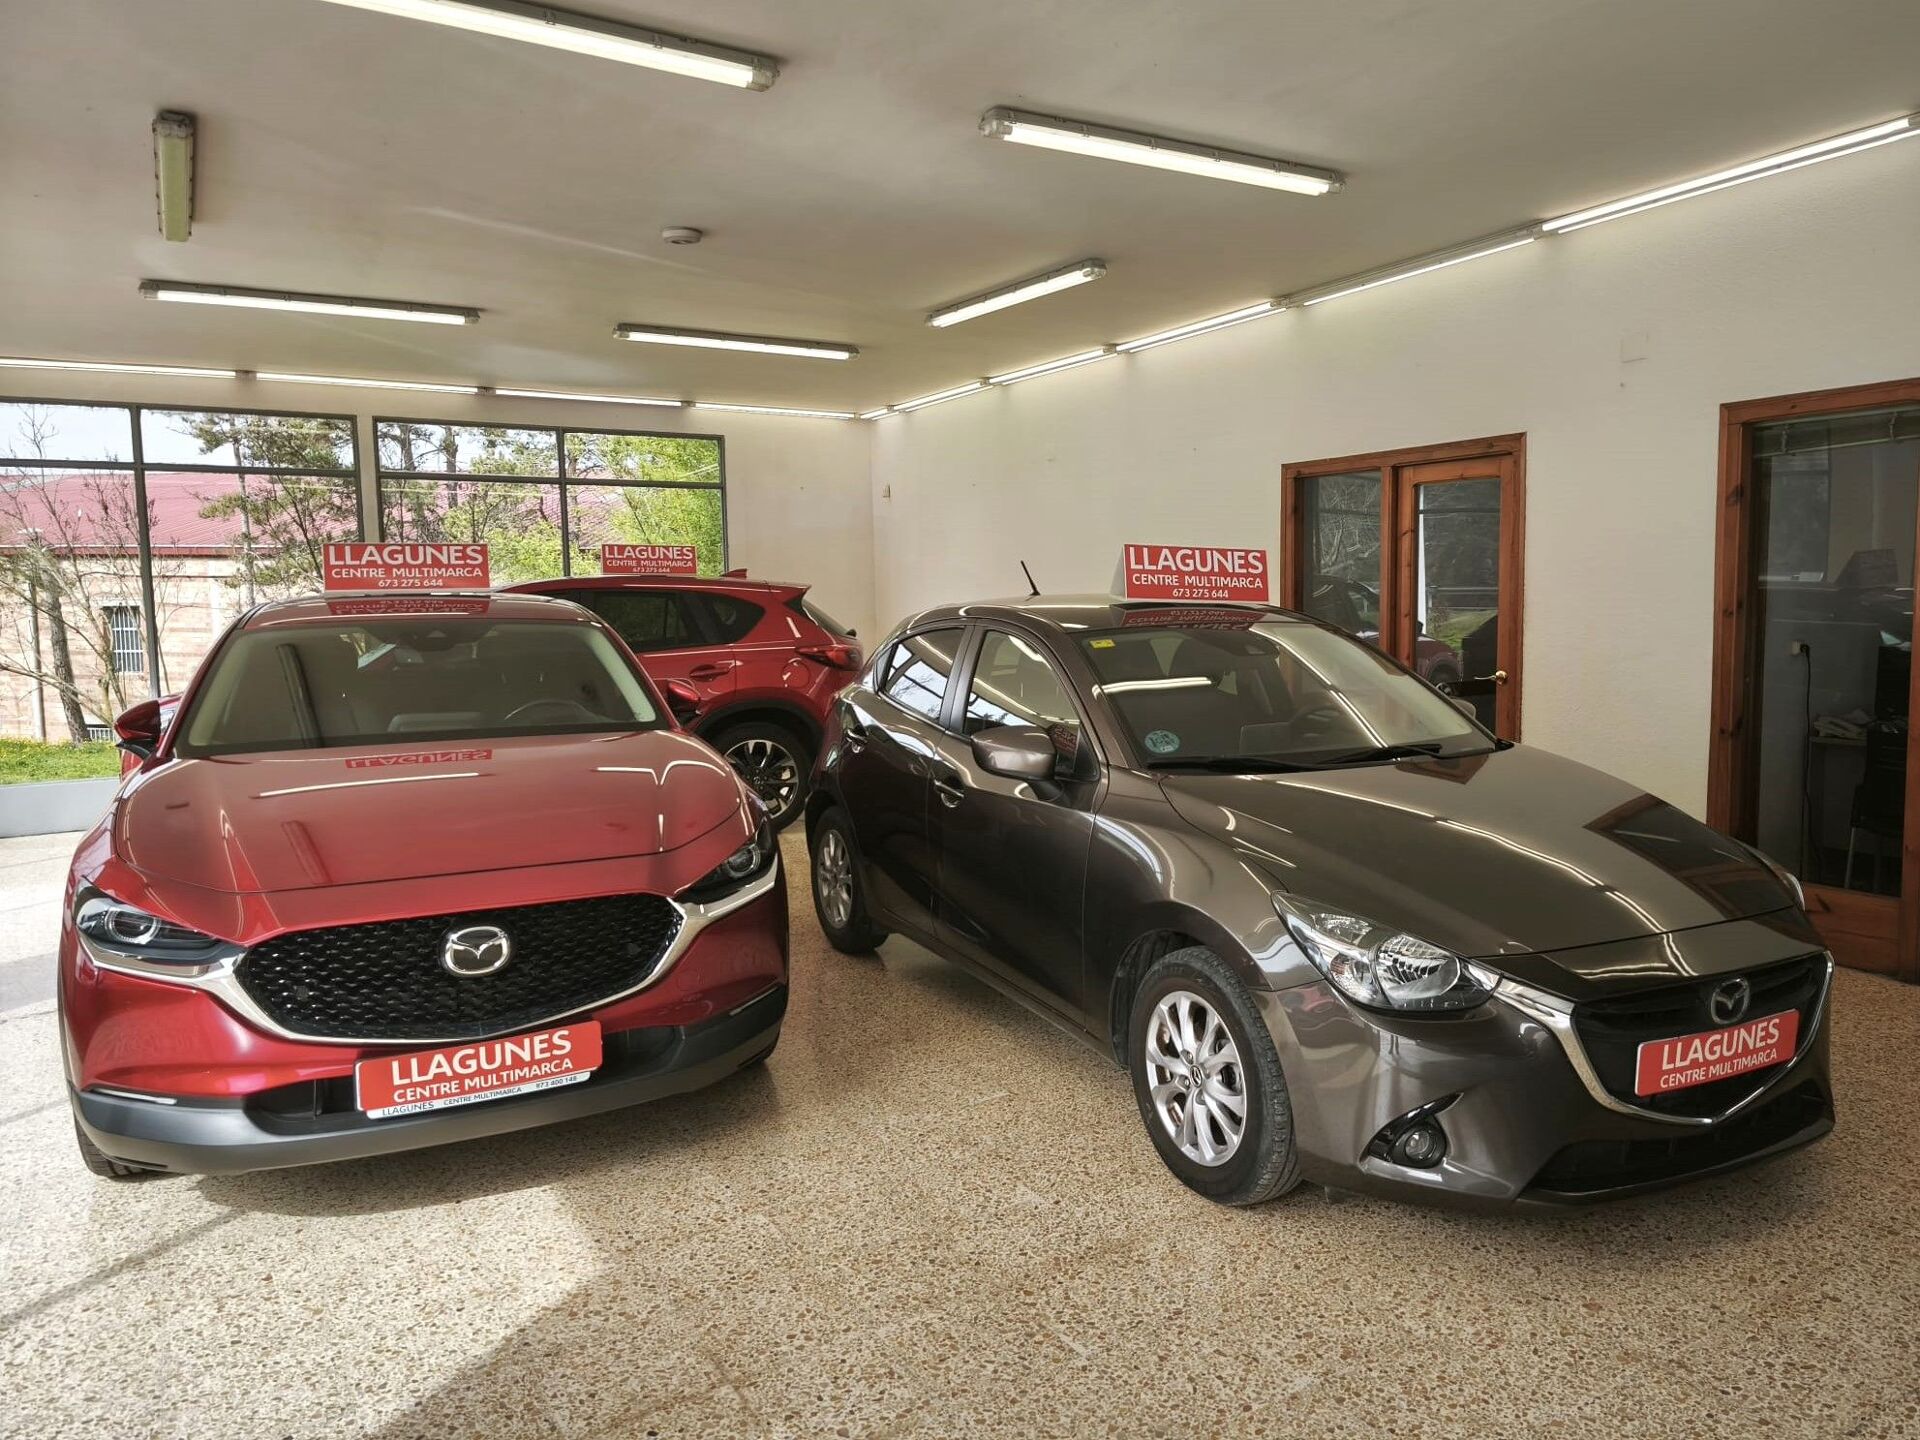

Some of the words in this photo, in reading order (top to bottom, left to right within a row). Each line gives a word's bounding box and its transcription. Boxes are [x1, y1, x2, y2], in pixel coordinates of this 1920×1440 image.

[329, 545, 483, 566] LLAGUNES
[605, 545, 693, 560] LLAGUNES
[1129, 546, 1264, 574] LLAGUNES
[332, 567, 386, 578] CENTRE
[393, 567, 483, 578] MULTIMARCA
[641, 560, 693, 568] MULTIMARCA
[378, 579, 398, 588] 673
[401, 579, 421, 587] 275
[423, 579, 443, 587] 644
[1132, 573, 1179, 586] CENTRE
[1185, 575, 1263, 589] MULTIMARCA
[1172, 588, 1190, 598] 673
[1192, 588, 1209, 598] 275
[1211, 589, 1229, 599] 644
[1662, 1018, 1780, 1070] LLAGUNES
[391, 1029, 572, 1086] LLAGUNES
[1660, 1067, 1706, 1089] CENTRE
[1708, 1048, 1777, 1077] MULTIMARCA
[393, 1079, 461, 1103] CENTRE
[464, 1057, 573, 1091] MULTIMARCA
[382, 1102, 435, 1116] LLAGUNES
[443, 1095, 472, 1106] CENTRE
[473, 1086, 522, 1100] MULTIMARCA
